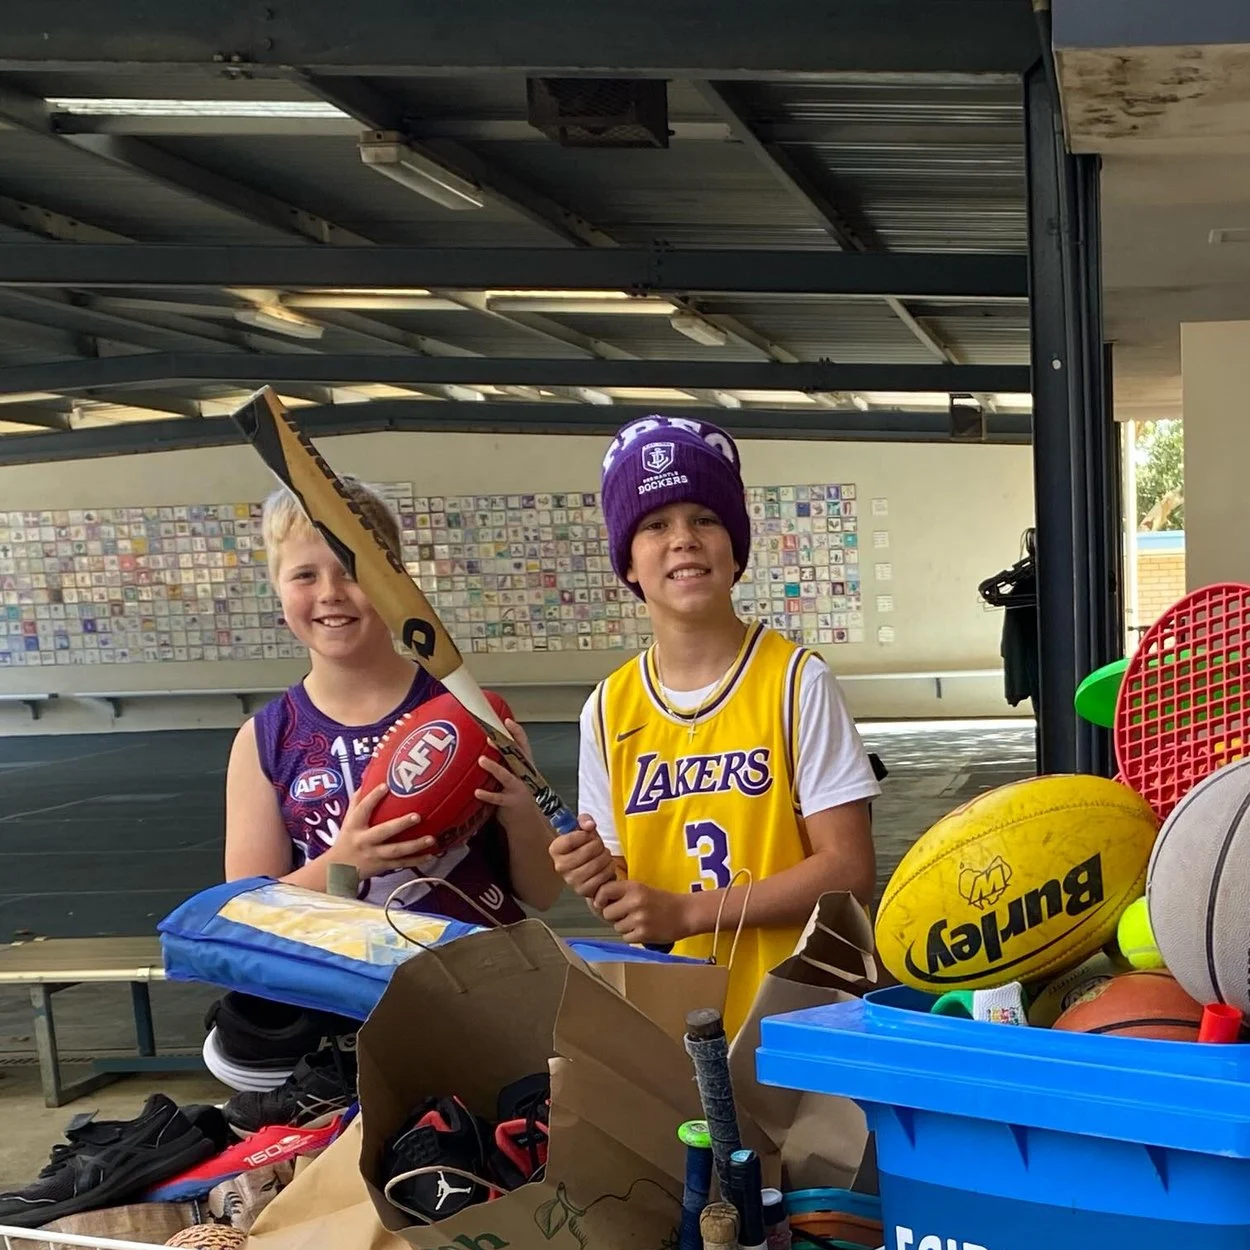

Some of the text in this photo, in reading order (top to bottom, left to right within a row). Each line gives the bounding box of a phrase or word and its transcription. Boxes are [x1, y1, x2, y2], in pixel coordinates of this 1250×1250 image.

[638, 475, 688, 494] DOCKERS
[296, 774, 334, 798] AFL
[394, 732, 455, 792] AFL
[625, 749, 773, 815] LAKERS
[685, 820, 732, 893] 3
[926, 851, 1104, 974] Burley
